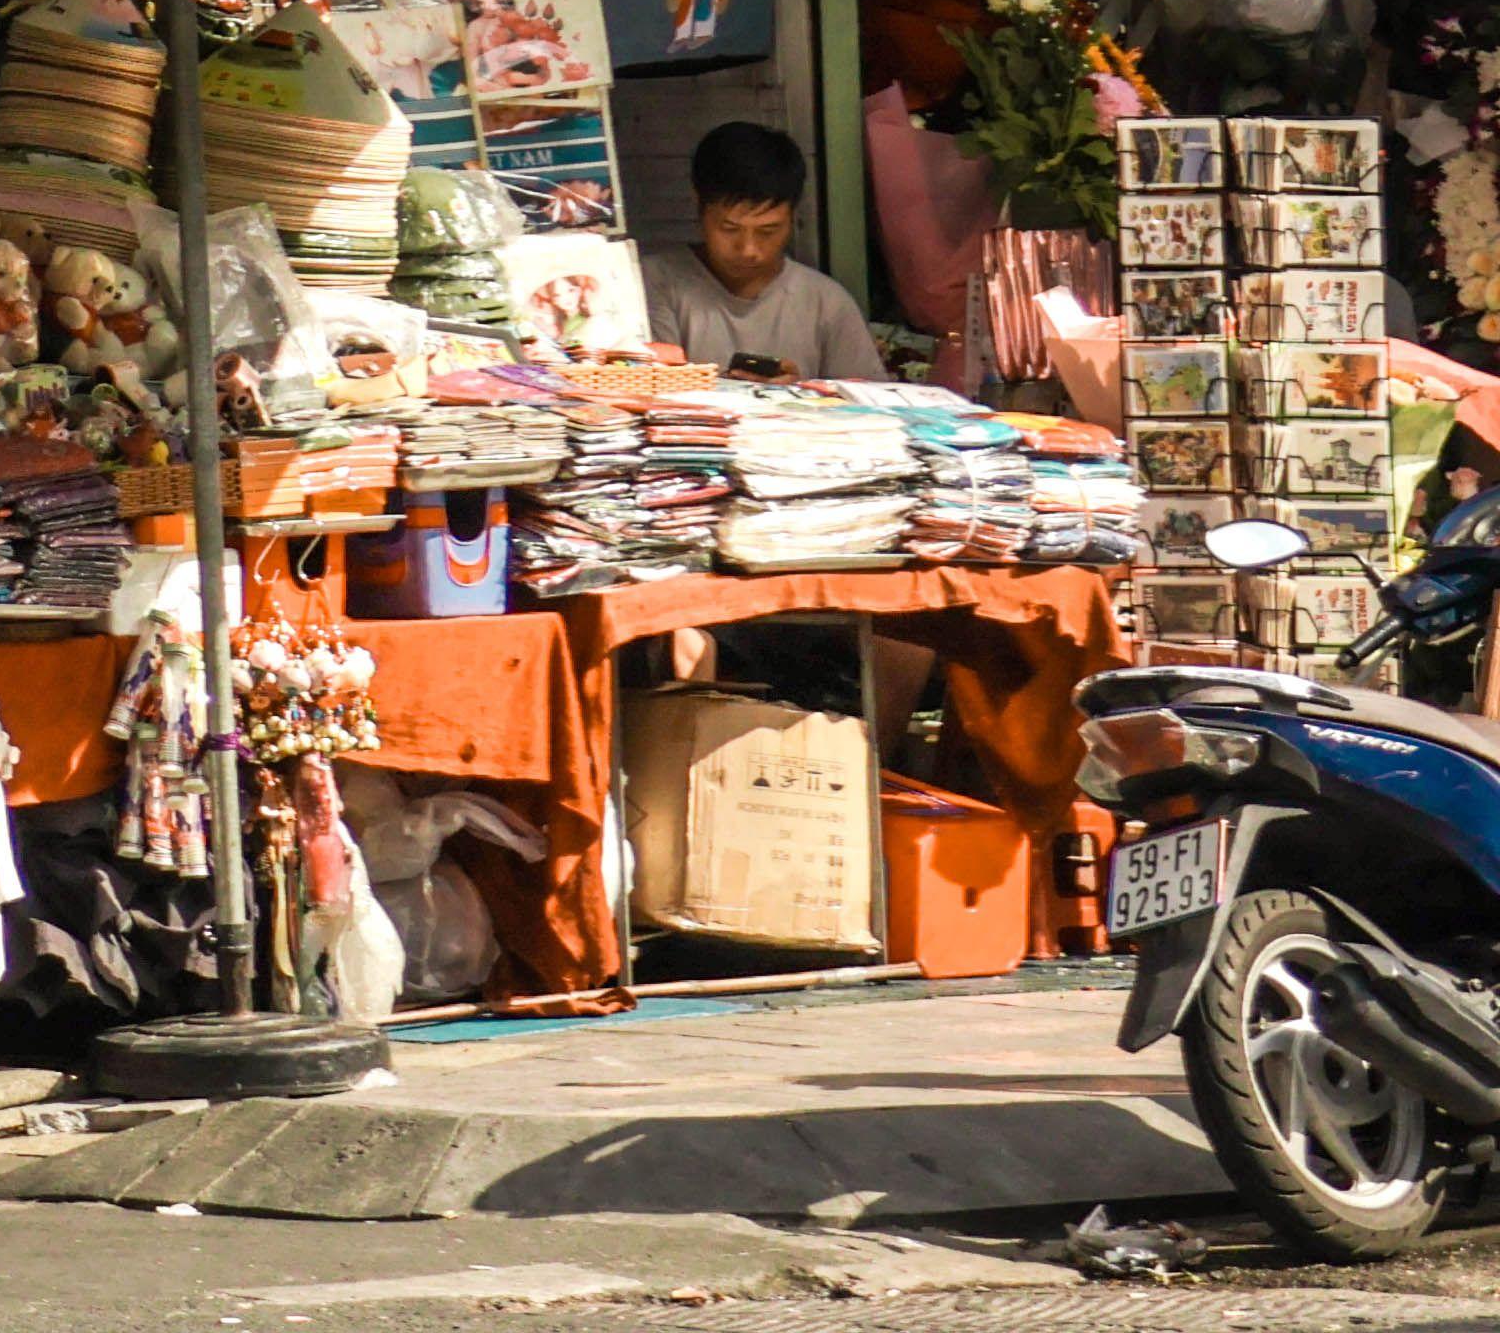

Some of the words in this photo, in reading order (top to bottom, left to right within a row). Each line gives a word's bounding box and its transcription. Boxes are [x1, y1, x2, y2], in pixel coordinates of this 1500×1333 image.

[510, 149, 554, 168] NAM
[1129, 829, 1203, 885] 59-F1
[1115, 869, 1214, 928] 925.93
